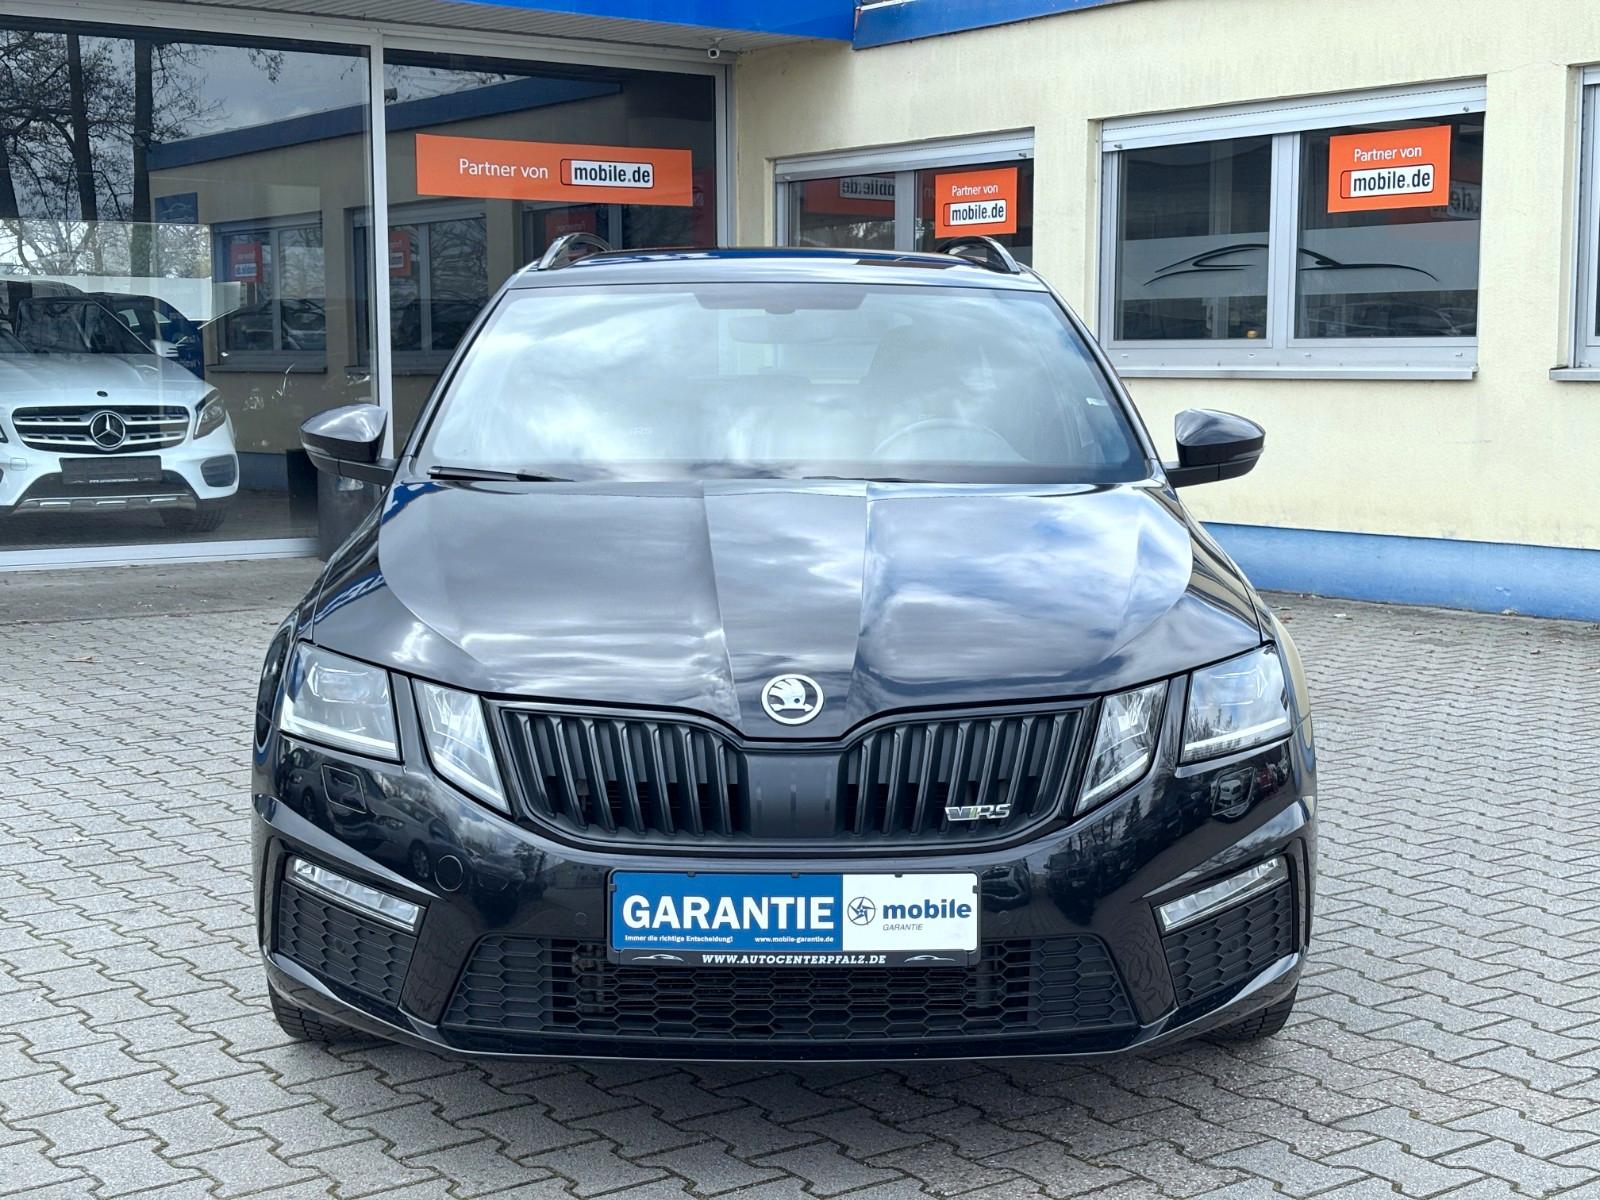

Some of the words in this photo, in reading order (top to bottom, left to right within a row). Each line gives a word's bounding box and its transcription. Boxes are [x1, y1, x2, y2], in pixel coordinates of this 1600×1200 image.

[1354, 148, 1397, 162] Partner
[1400, 147, 1422, 158] von
[459, 158, 516, 177] Partner
[520, 165, 548, 179] von
[574, 164, 650, 183] mobile.de
[1353, 169, 1430, 192] mobile.de
[952, 184, 980, 197] Partner
[983, 184, 998, 195] von
[952, 203, 1004, 222] mobile.de
[622, 895, 834, 930] GARANTIE
[882, 899, 972, 920] mobile
[883, 923, 923, 931] GARANTIE
[648, 934, 658, 942] die
[659, 934, 685, 943] richtige
[686, 935, 734, 944] Entscheidung!
[754, 936, 834, 944] www.mobile-garantie.de
[702, 953, 887, 965] WWW.AUTOCENTERPFALZ.DE
